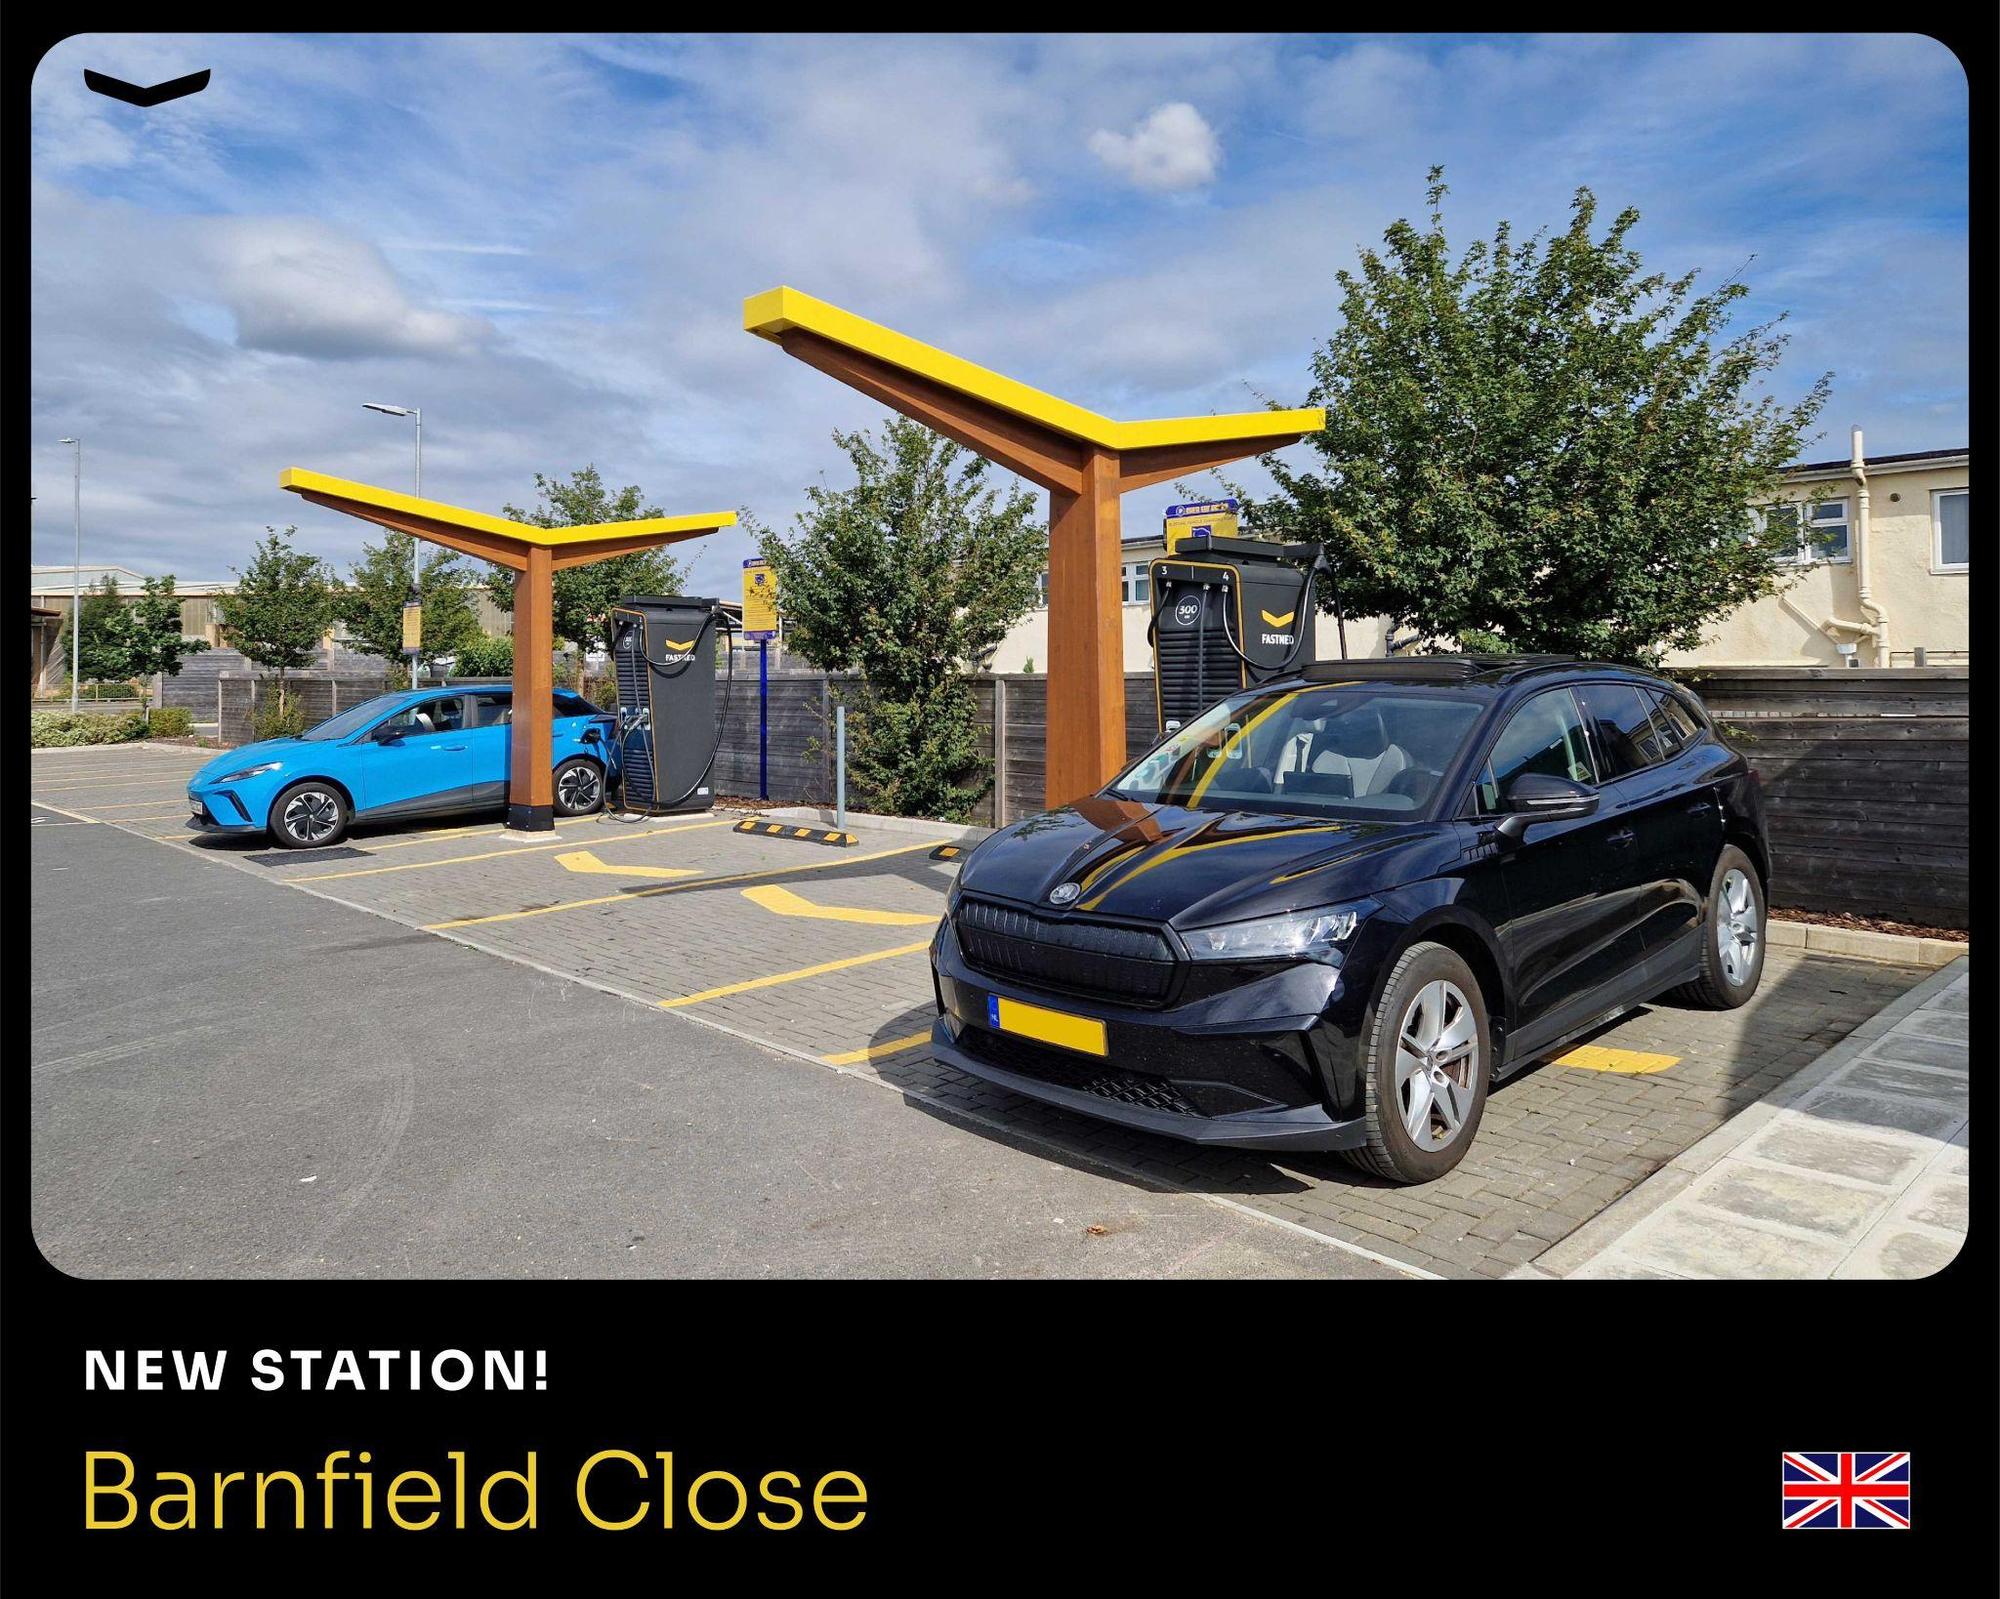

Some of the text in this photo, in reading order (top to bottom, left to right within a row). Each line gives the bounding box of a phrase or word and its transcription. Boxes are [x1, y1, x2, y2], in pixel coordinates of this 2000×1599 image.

[1161, 566, 1168, 575] 3
[1222, 572, 1229, 581] 4
[1179, 605, 1198, 615] 300
[1261, 633, 1295, 645] FASTNED
